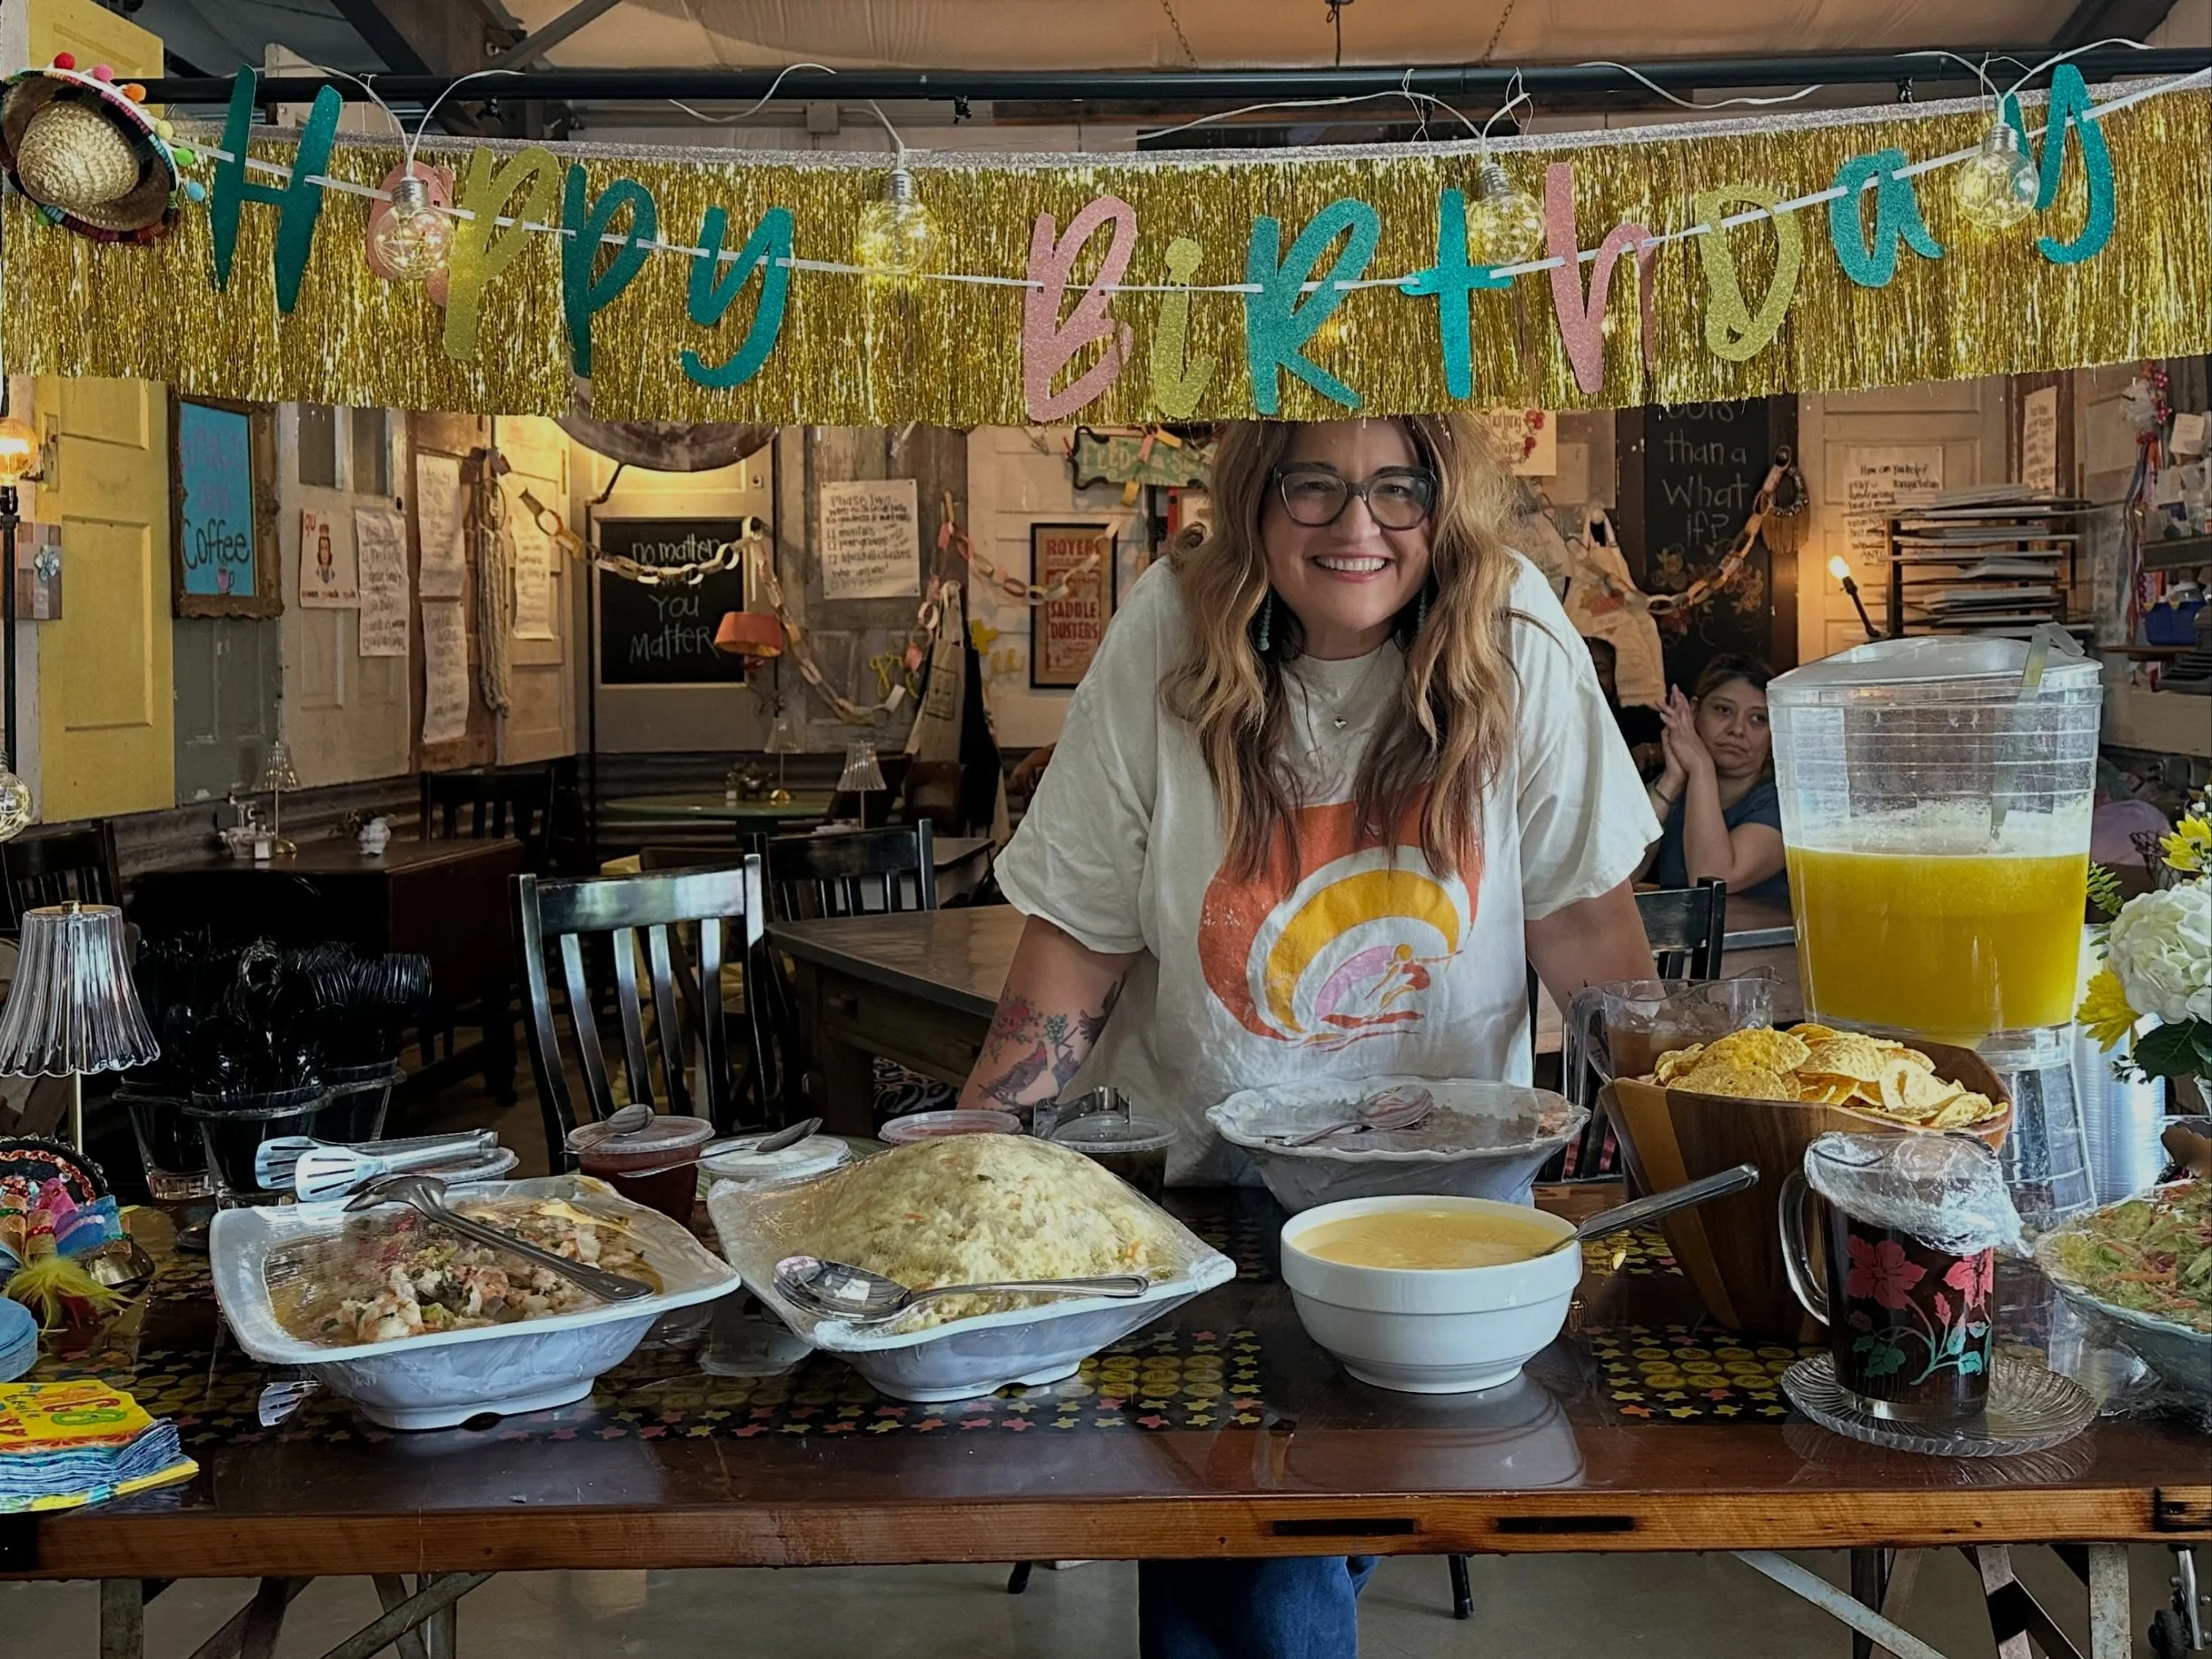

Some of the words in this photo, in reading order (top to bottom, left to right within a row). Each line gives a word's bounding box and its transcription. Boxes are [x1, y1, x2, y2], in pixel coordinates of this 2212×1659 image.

[1663, 428, 1724, 465] than
[1731, 446, 1747, 465] a
[1663, 472, 1750, 511] What
[182, 517, 250, 571] Coffee
[1686, 510, 1730, 547] if?
[657, 533, 721, 564] matter
[648, 594, 700, 623] You
[1050, 602, 1097, 618] SADDLE
[1050, 622, 1099, 640] DUSTERS
